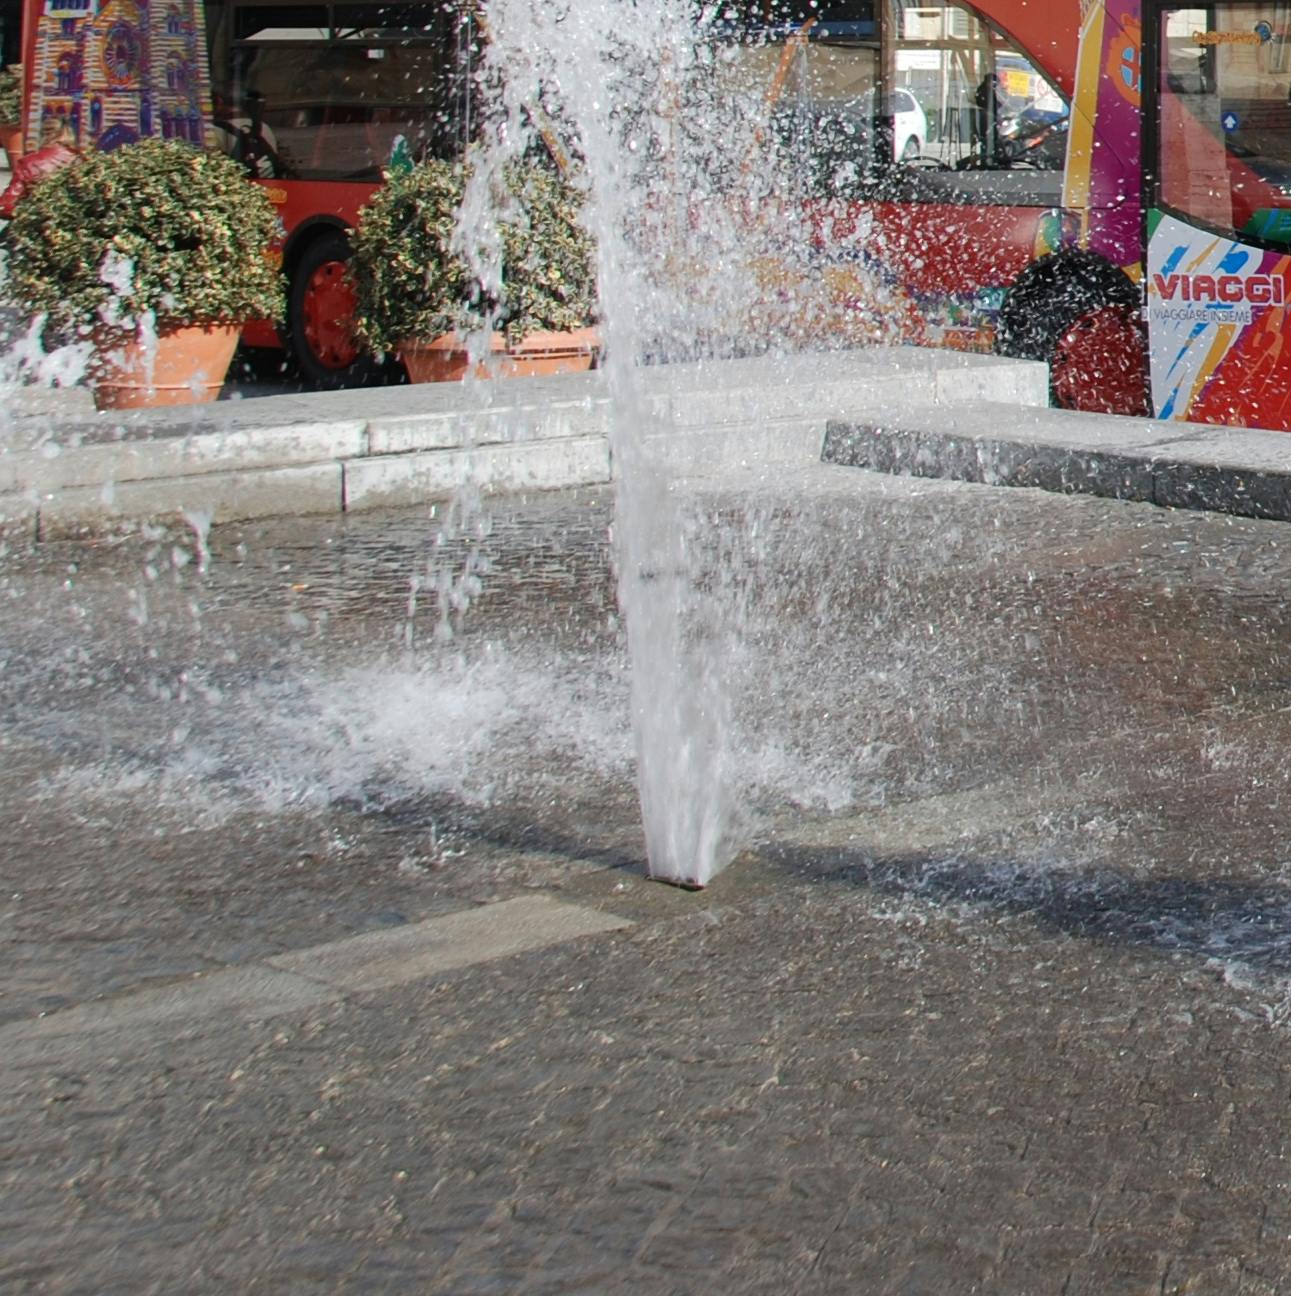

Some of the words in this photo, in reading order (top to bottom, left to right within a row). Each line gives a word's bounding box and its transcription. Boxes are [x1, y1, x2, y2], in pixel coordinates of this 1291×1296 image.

[1153, 273, 1284, 304] VIAGGI
[1154, 309, 1208, 321] VIAGGIARE
[1209, 311, 1251, 323] INSIEME
